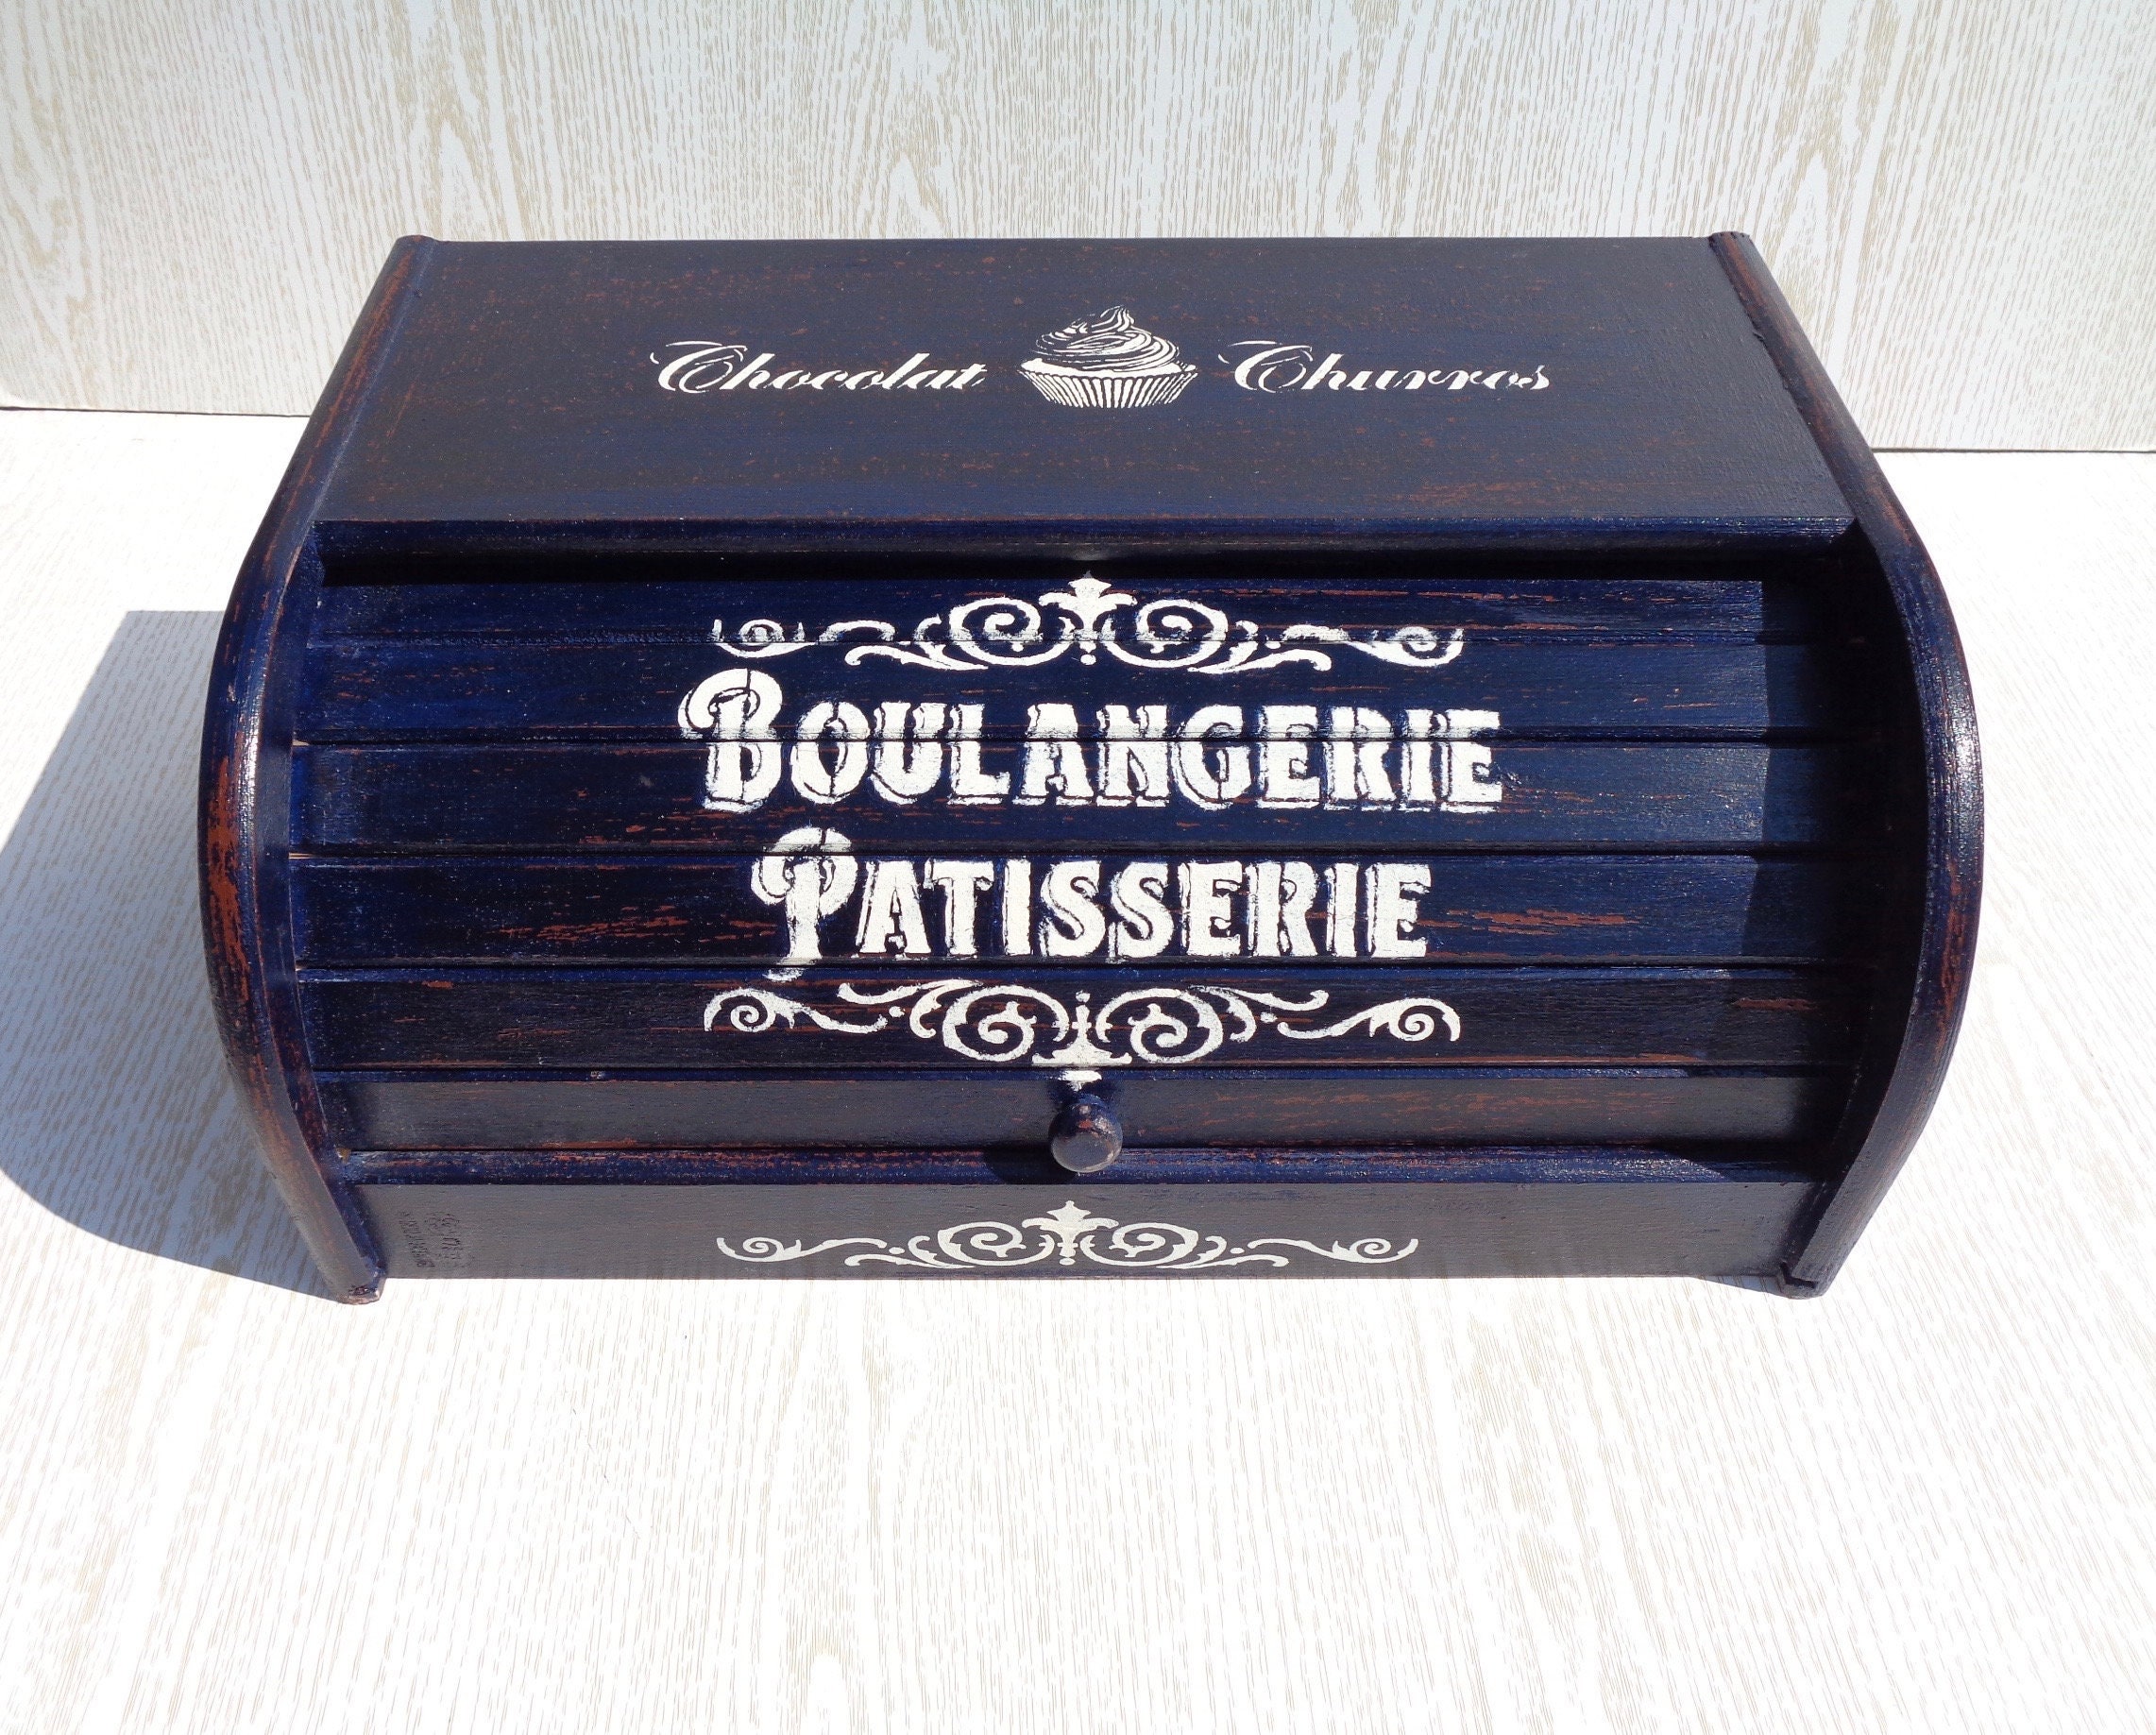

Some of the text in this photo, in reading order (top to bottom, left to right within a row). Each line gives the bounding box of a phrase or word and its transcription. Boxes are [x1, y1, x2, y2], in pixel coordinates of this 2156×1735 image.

[649, 340, 1550, 394] Chocolat Churros
[677, 667, 1503, 813] BOULANGERIE
[751, 826, 1432, 981] PATISSERIE
